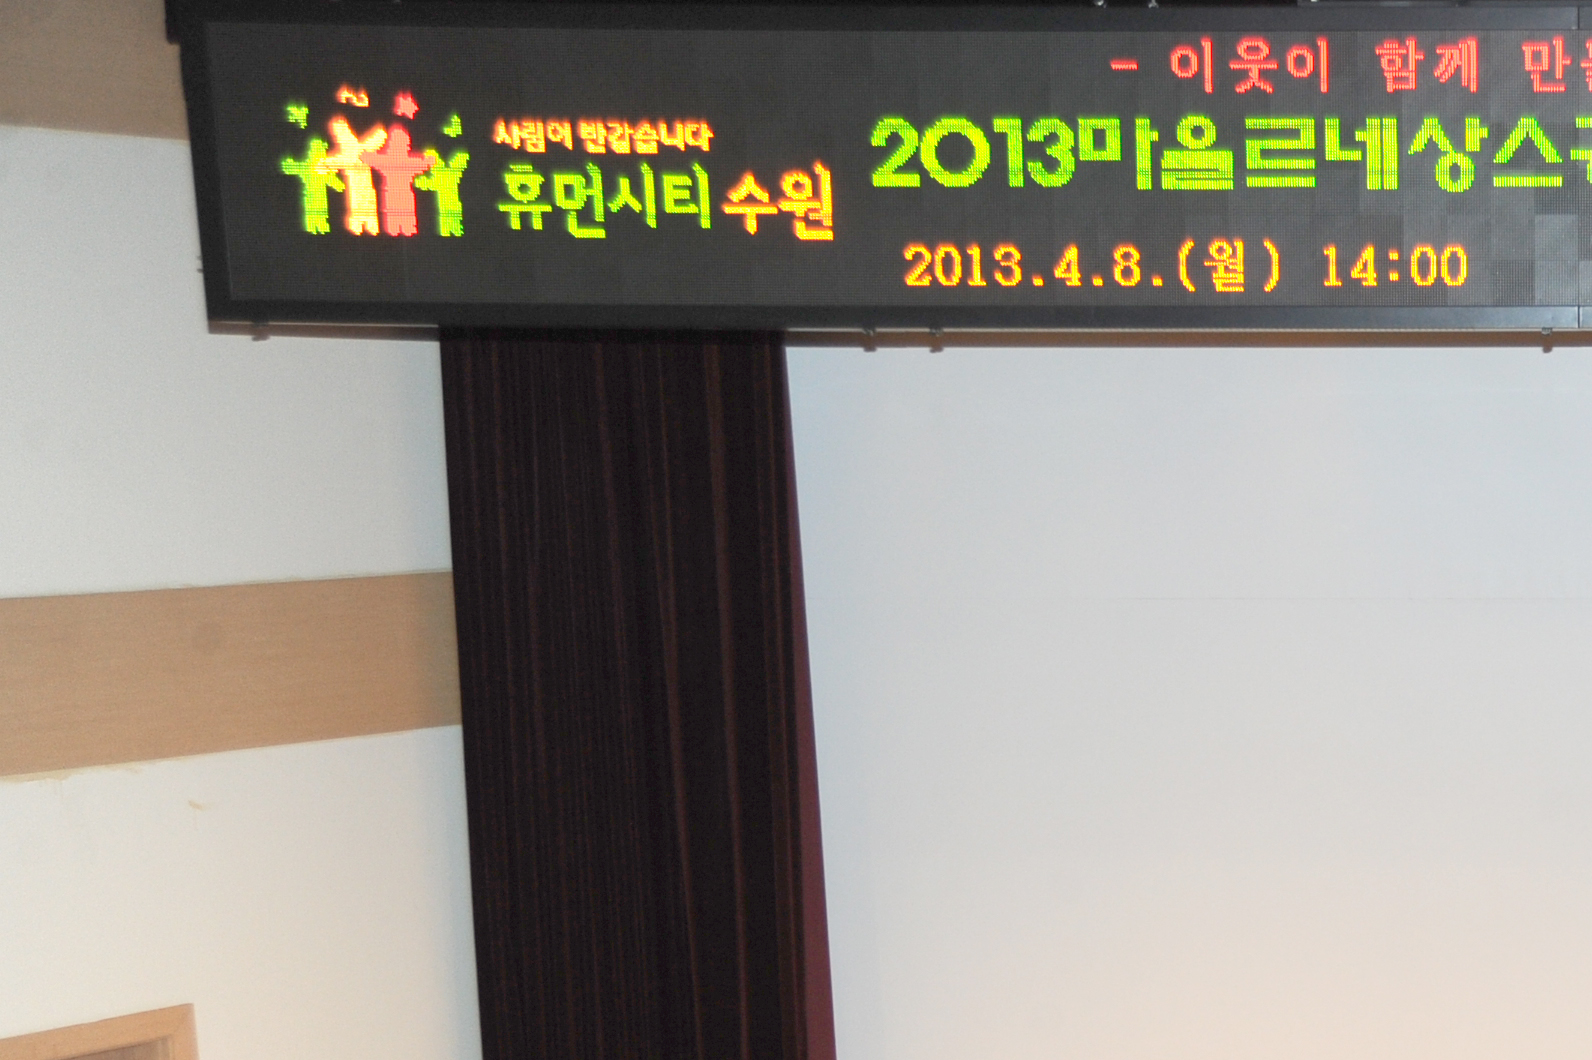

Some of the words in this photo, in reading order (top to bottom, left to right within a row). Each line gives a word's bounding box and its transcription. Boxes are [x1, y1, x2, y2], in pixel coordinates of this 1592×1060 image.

[1171, 37, 1329, 94] 이웃이
[1376, 38, 1478, 93] 함께
[577, 119, 715, 154] 반갑습니다
[499, 162, 711, 238] 휴먼시티
[722, 161, 835, 241] 수원
[904, 238, 1280, 292] 2013.4.8.(월)
[1324, 245, 1468, 287] 14:00
